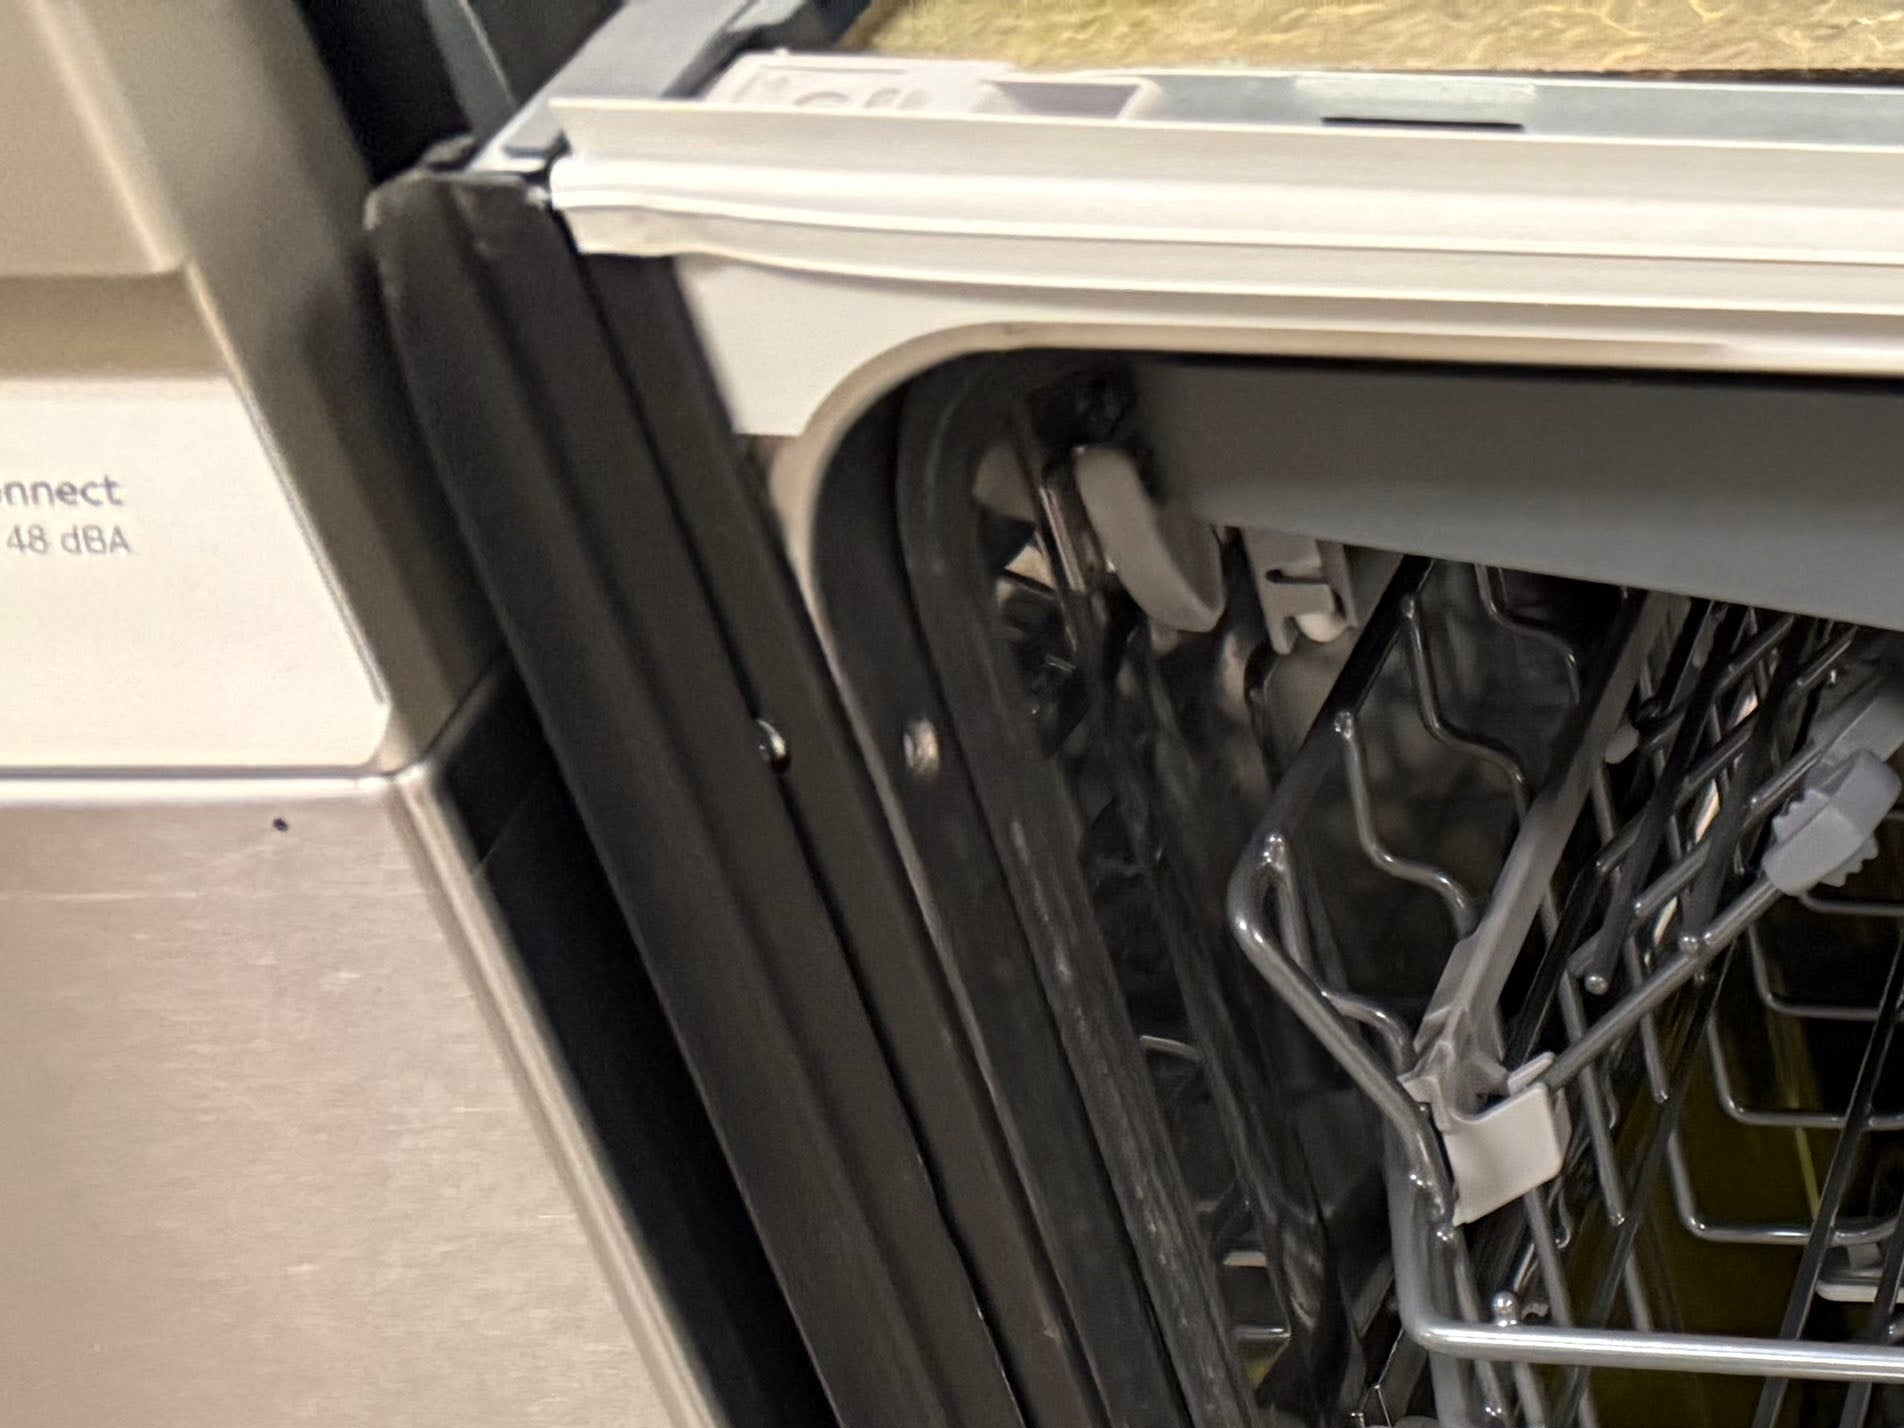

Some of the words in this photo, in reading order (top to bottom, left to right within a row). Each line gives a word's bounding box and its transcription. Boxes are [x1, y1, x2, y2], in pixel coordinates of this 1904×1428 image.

[0, 475, 123, 506] nnect
[7, 524, 50, 555] 48
[60, 524, 131, 555] dBA
